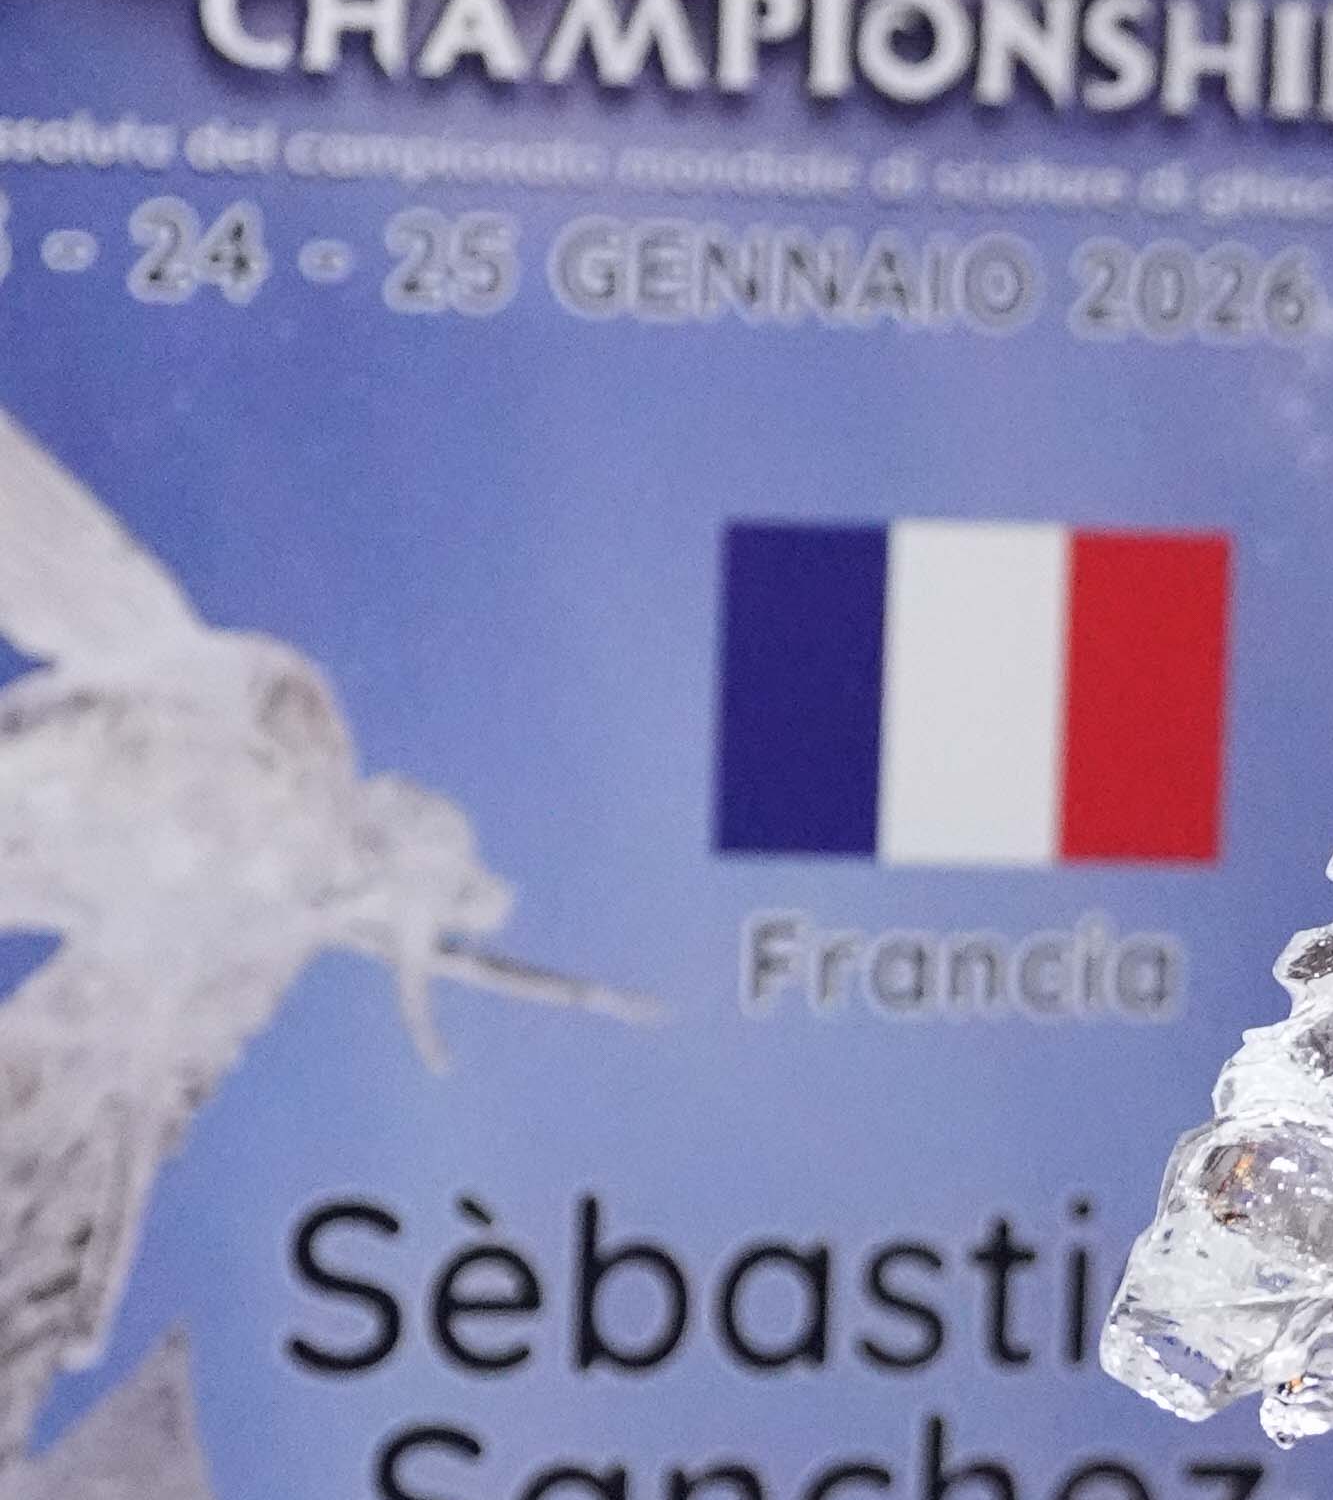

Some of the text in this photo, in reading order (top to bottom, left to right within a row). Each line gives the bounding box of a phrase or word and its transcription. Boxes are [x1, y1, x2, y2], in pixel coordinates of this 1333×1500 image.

[132, 200, 264, 299] 24
[390, 212, 514, 311] 25
[556, 220, 1030, 326] GENNAIO
[1074, 235, 1316, 341] 2026
[744, 915, 1182, 1016] Francia
[284, 1192, 1094, 1373] Sèbasti
